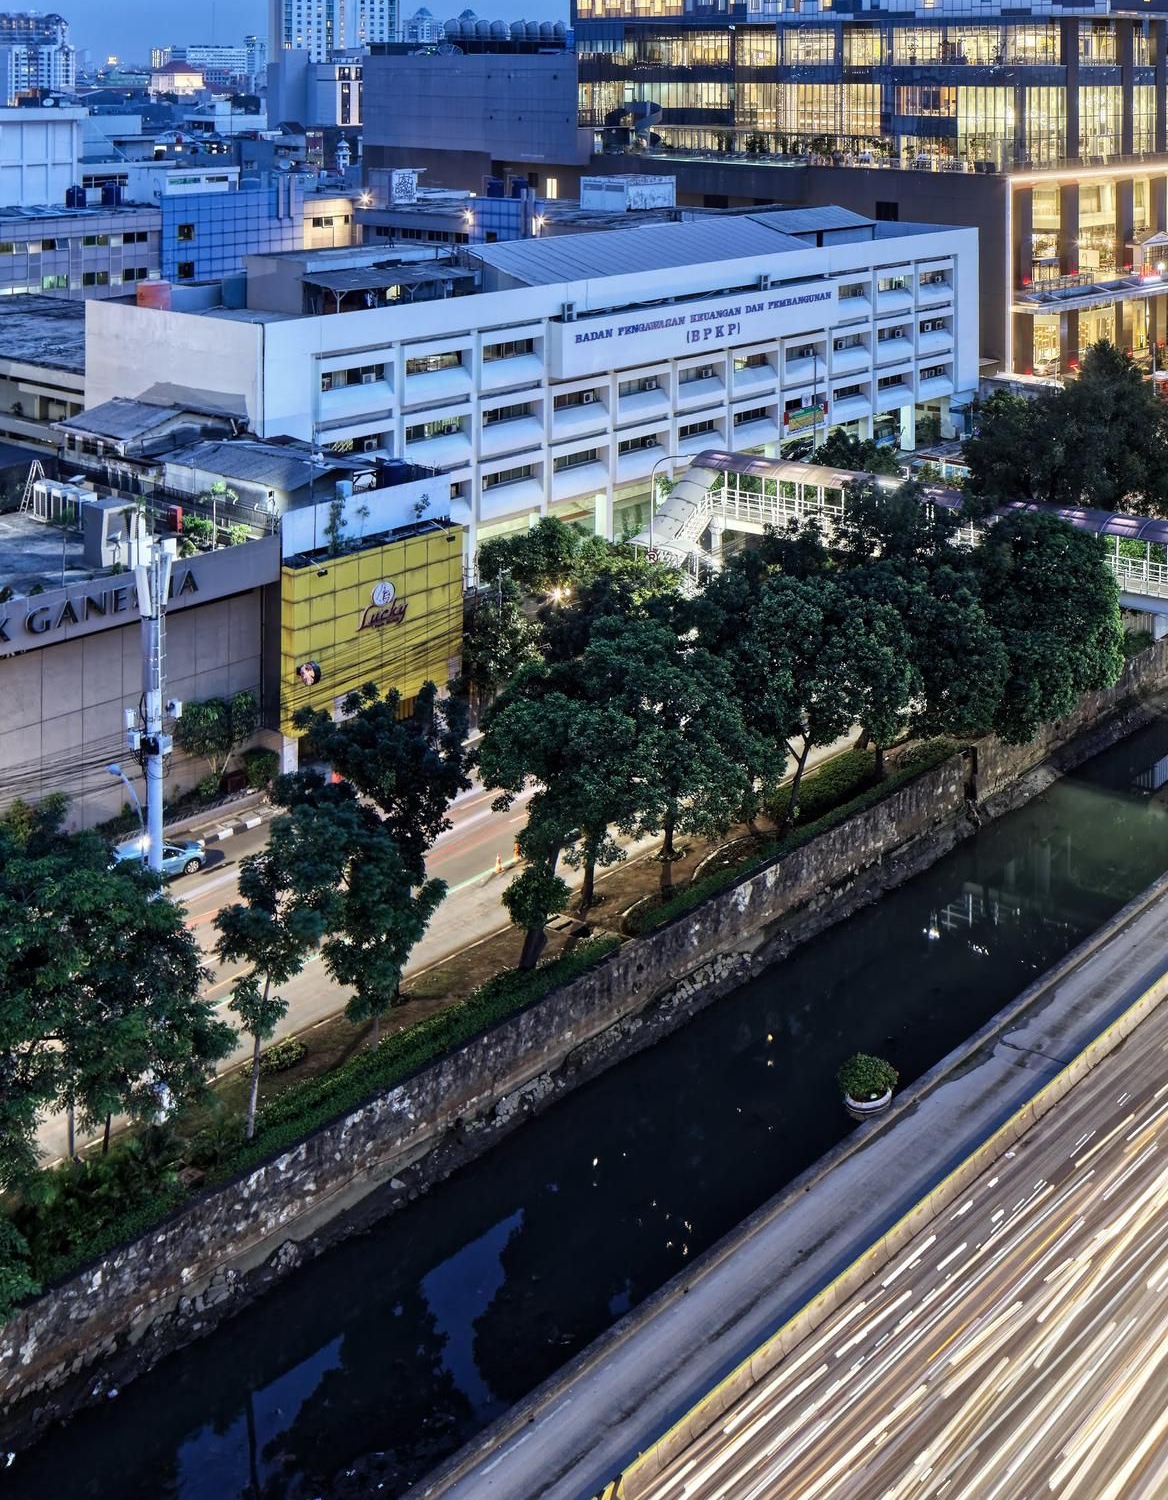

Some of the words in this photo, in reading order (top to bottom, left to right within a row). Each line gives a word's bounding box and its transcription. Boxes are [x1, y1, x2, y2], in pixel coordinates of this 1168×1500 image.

[575, 328, 613, 344] BADAN
[617, 316, 686, 337] PENGAWASAN
[690, 306, 742, 324] KEUANGAN
[745, 301, 765, 315] DAN
[767, 291, 833, 311] PEMBANGUNAN
[24, 569, 200, 635] GANEA
[355, 597, 408, 632] Lucky
